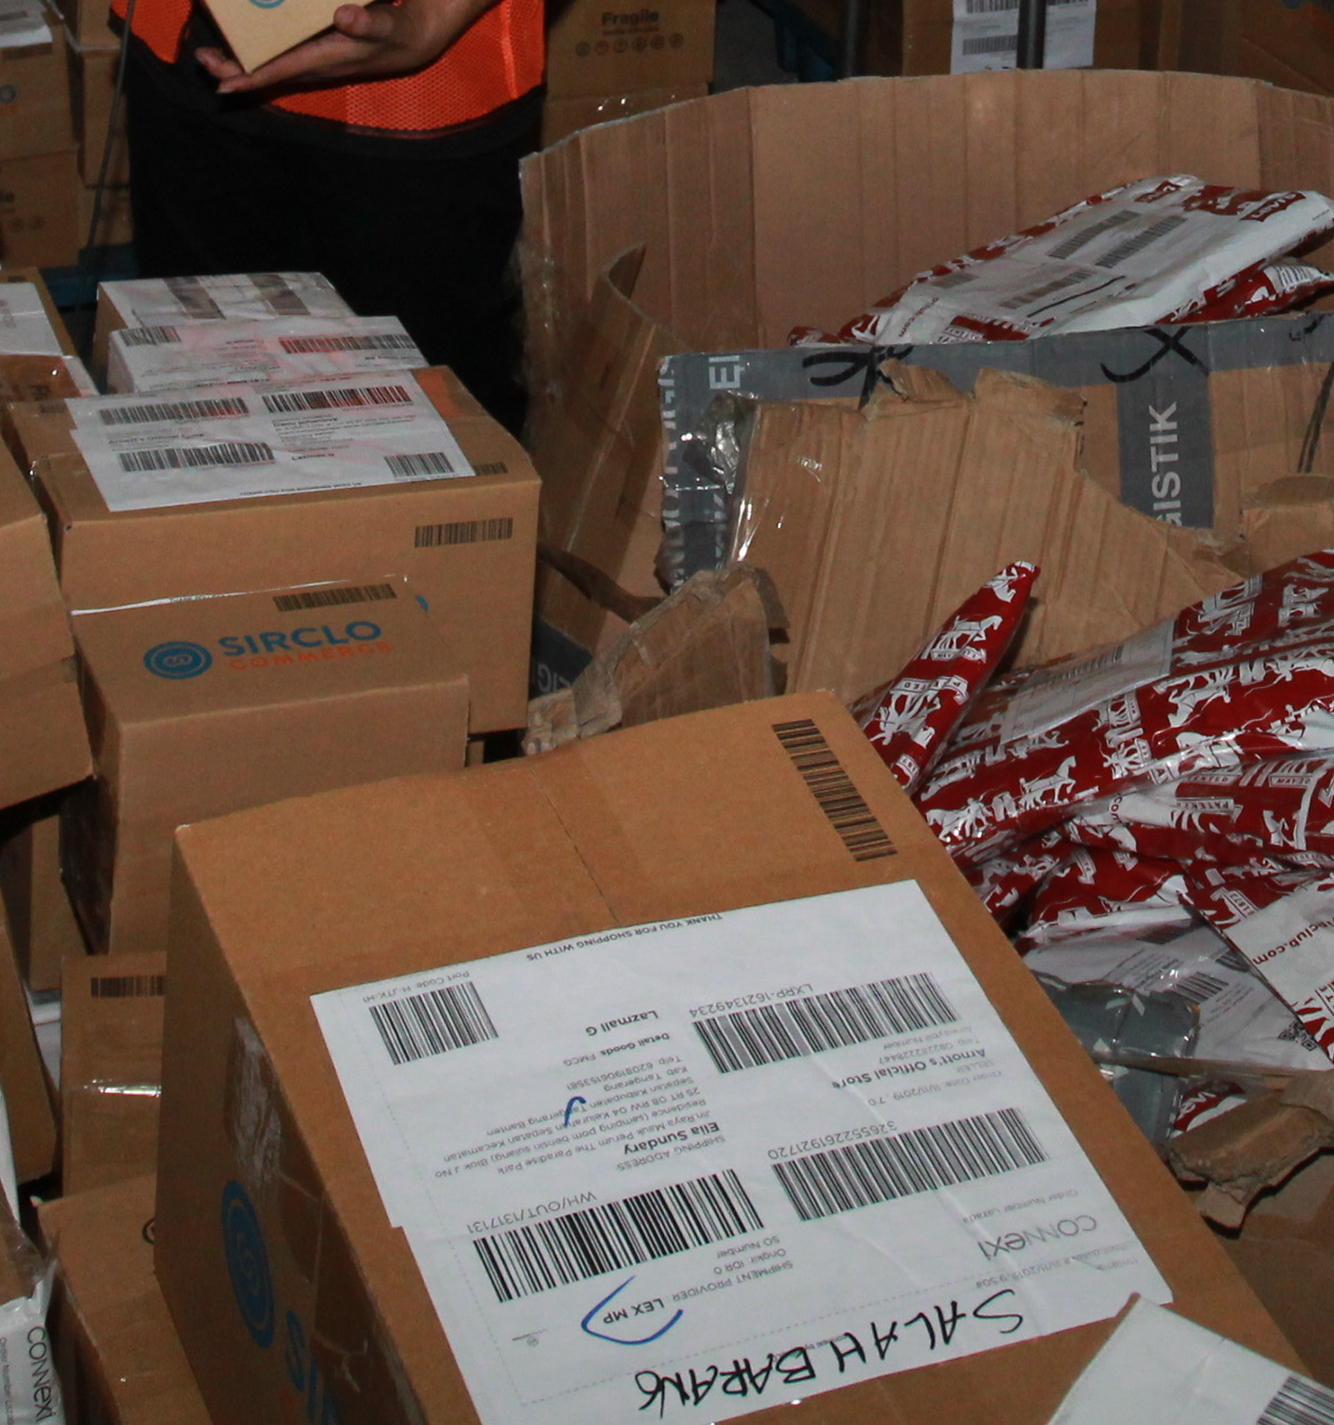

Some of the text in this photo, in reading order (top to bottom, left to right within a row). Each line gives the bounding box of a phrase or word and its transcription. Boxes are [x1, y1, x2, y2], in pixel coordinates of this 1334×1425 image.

[601, 8, 660, 28] Fragile
[1148, 400, 1181, 528] GISTIK
[218, 623, 382, 657] SIRCLO
[226, 640, 392, 672] COMMERCE
[526, 911, 722, 962] THANK YOU FOR SHOPPING WITH US
[688, 981, 812, 1019] LXRP-1621349234
[585, 1008, 658, 1038] Lazmall G
[637, 1031, 669, 1049] Detail
[563, 1052, 595, 1068] FMCG
[831, 1046, 986, 1091] Arnott's Official Store
[588, 1088, 648, 1111] Kabupaten
[650, 1075, 693, 1095] Sepatan
[486, 1120, 525, 1138] Banten
[672, 1134, 725, 1156] SHIPPING
[767, 1119, 896, 1161] 326552261921720
[466, 1190, 596, 1235] WH/OUT/1317131
[715, 1234, 780, 1260] SO Number
[601, 1260, 793, 1325] SHIPMENT PROVIDER LEX MP
[636, 1286, 1024, 1417] SALAH BARANG
